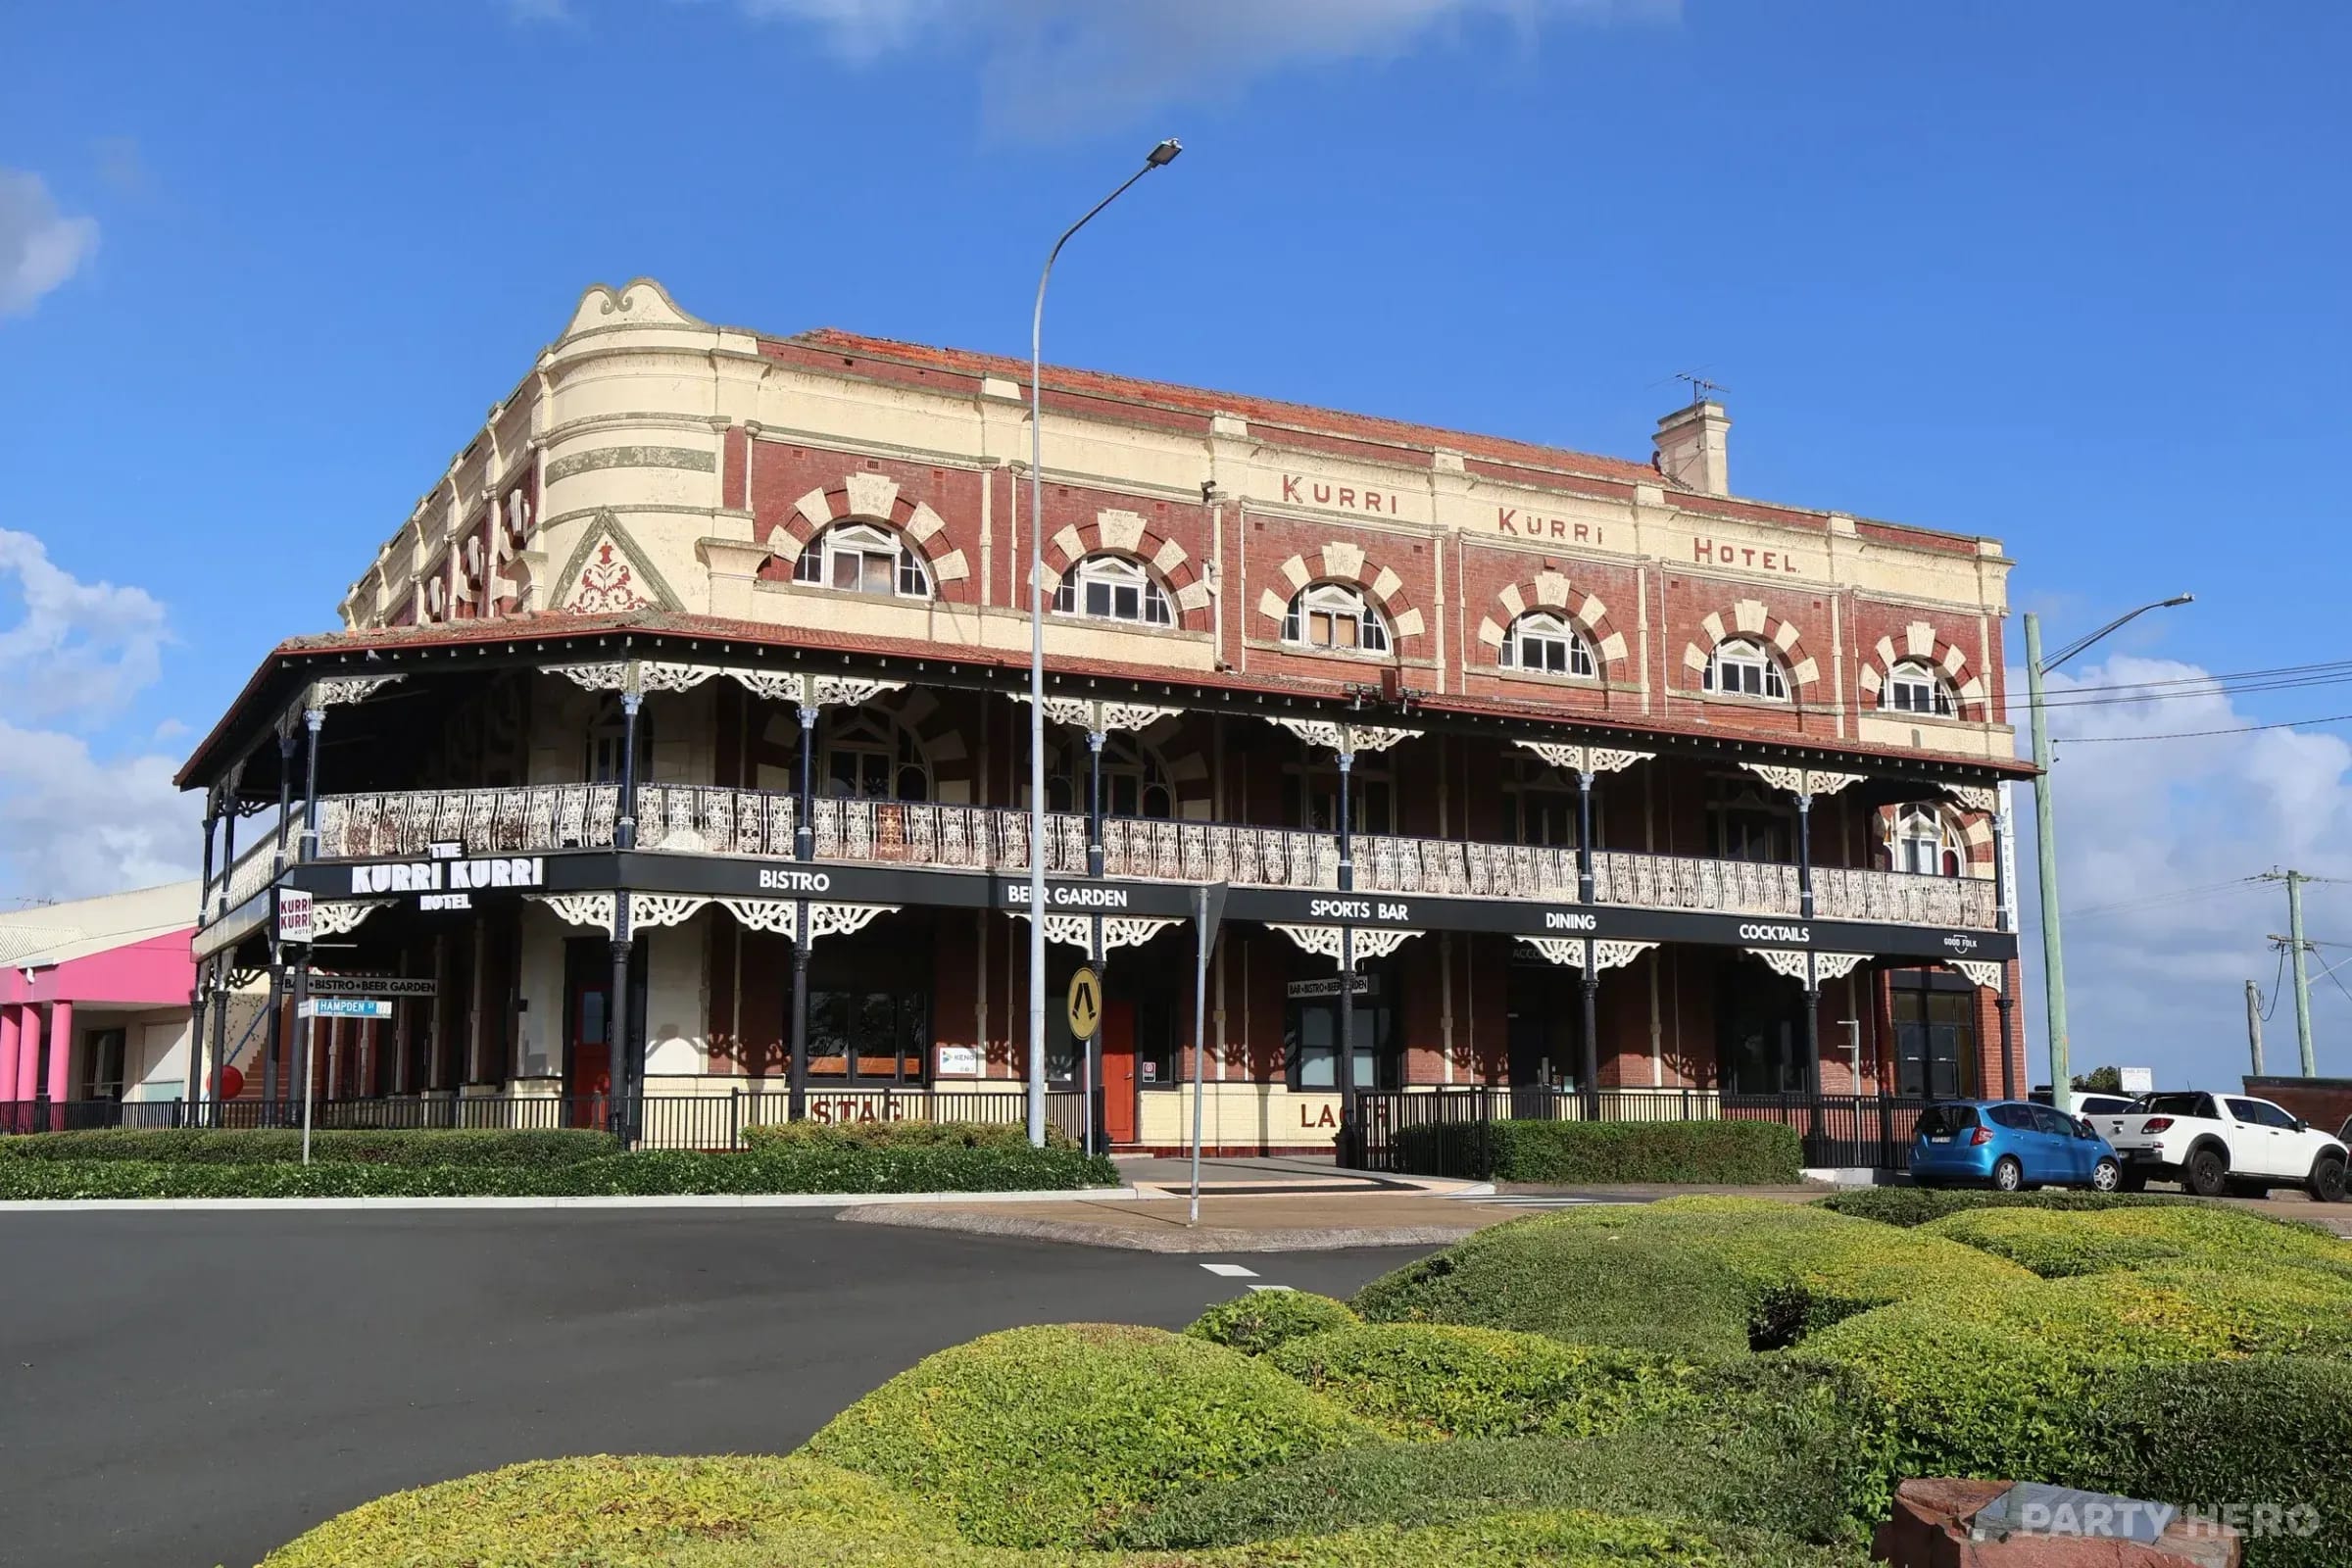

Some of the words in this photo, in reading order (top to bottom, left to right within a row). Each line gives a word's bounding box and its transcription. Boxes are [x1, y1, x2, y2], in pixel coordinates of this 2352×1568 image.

[1282, 473, 1397, 514] KURRI
[1498, 507, 1603, 545] KURRI
[430, 843, 462, 858] THE
[352, 862, 441, 894] KURRI
[450, 858, 543, 889] KURRI
[760, 869, 829, 892] BISTRO
[419, 894, 471, 910] HOTEL
[1007, 885, 1052, 904] BER
[1054, 887, 1128, 907] GARDEN
[280, 898, 312, 914] KURRI
[1310, 900, 1370, 918] SPORTS
[1378, 904, 1409, 920] BAR
[280, 913, 312, 930] KURRI
[1545, 912, 1596, 930] DINING
[1740, 923, 1810, 942] COCKTAILS
[1943, 937, 1961, 947] GOOD
[315, 980, 355, 990] BISTRO
[361, 981, 388, 992] BEER
[390, 982, 436, 993] GARDEN
[320, 1001, 365, 1012] HAMPDEN
